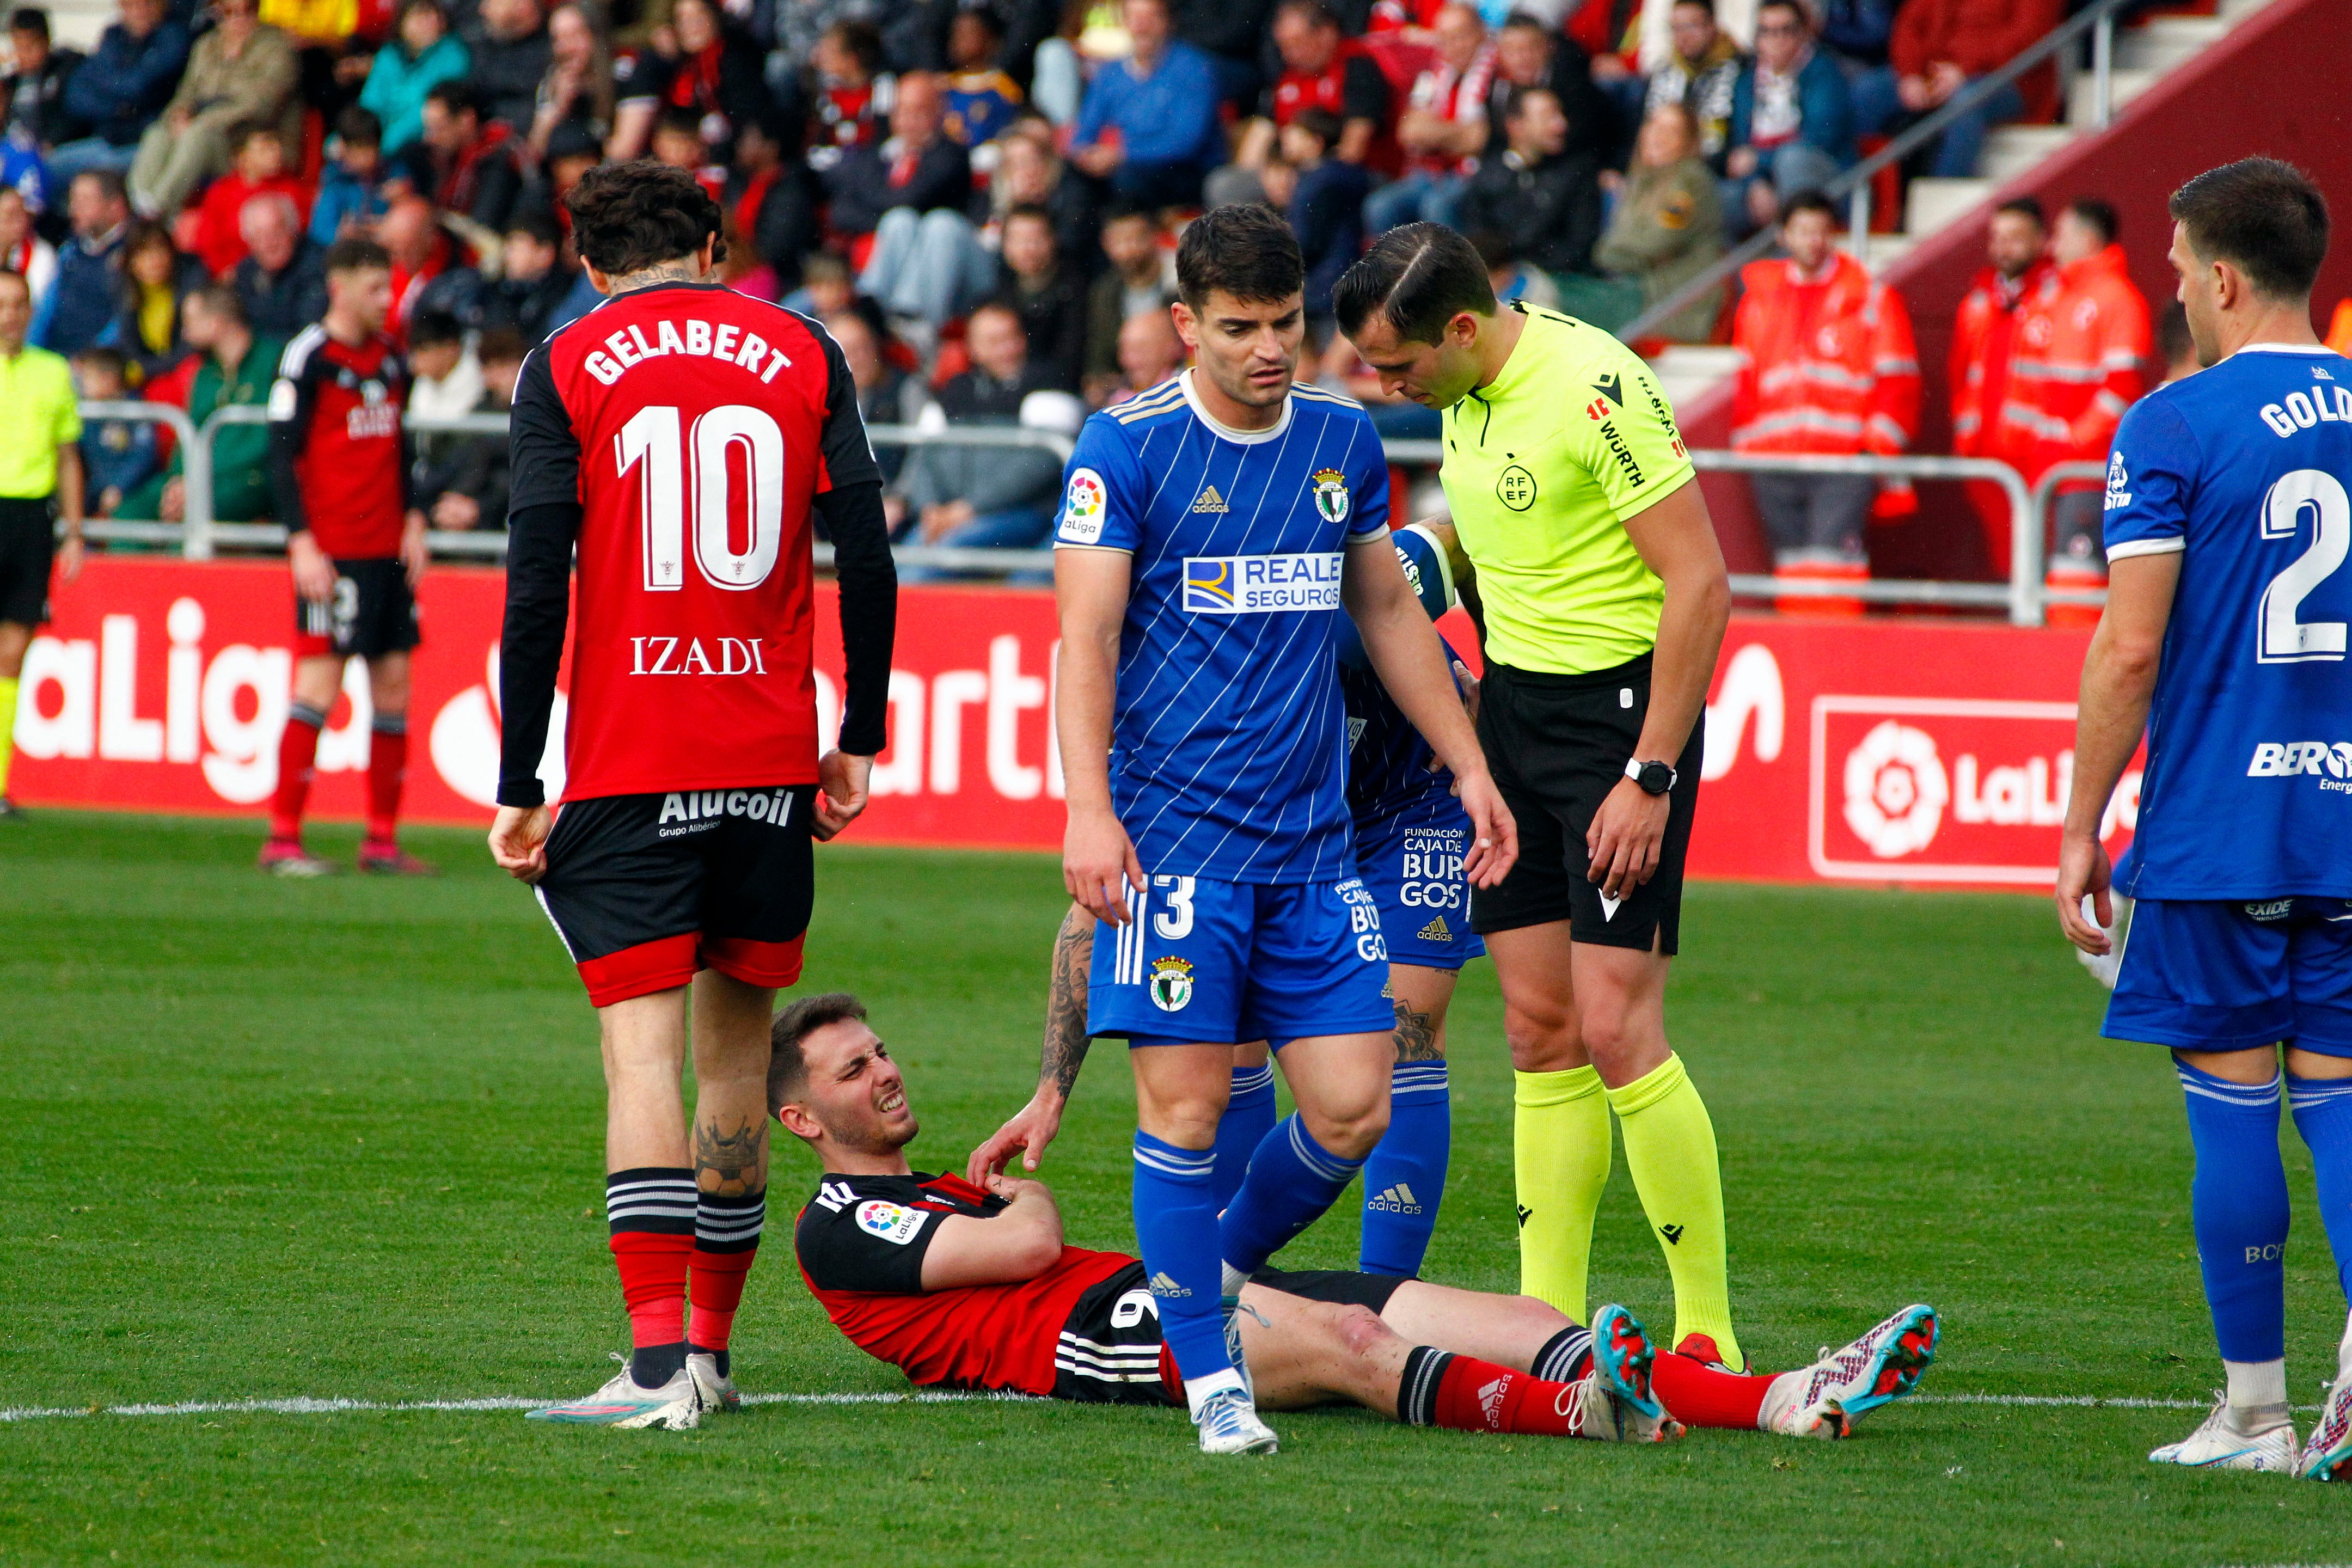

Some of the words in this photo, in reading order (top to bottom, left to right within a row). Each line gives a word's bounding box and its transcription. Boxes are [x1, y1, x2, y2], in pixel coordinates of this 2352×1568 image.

[584, 319, 791, 385] GELABERT
[2260, 385, 2352, 438] GOLD
[614, 405, 784, 591] 10
[1192, 504, 1229, 513] adidas
[1245, 556, 1342, 585] REALE
[2257, 469, 2350, 664] 2
[1245, 587, 1339, 608] SEGUROS
[629, 636, 767, 675] IZADI
[658, 788, 794, 827] Alucoil
[659, 826, 687, 837] Grupo
[1405, 828, 1465, 838] FUNDACIÓN
[1404, 838, 1443, 854] CAJA
[1446, 840, 1462, 853] DE
[1402, 853, 1463, 881] BUR
[1400, 881, 1462, 909] GOS
[1417, 930, 1453, 942] adidas
[1368, 1199, 1422, 1215] adidas
[895, 1212, 918, 1240] LaLiga
[1491, 1374, 1513, 1428] adidas
